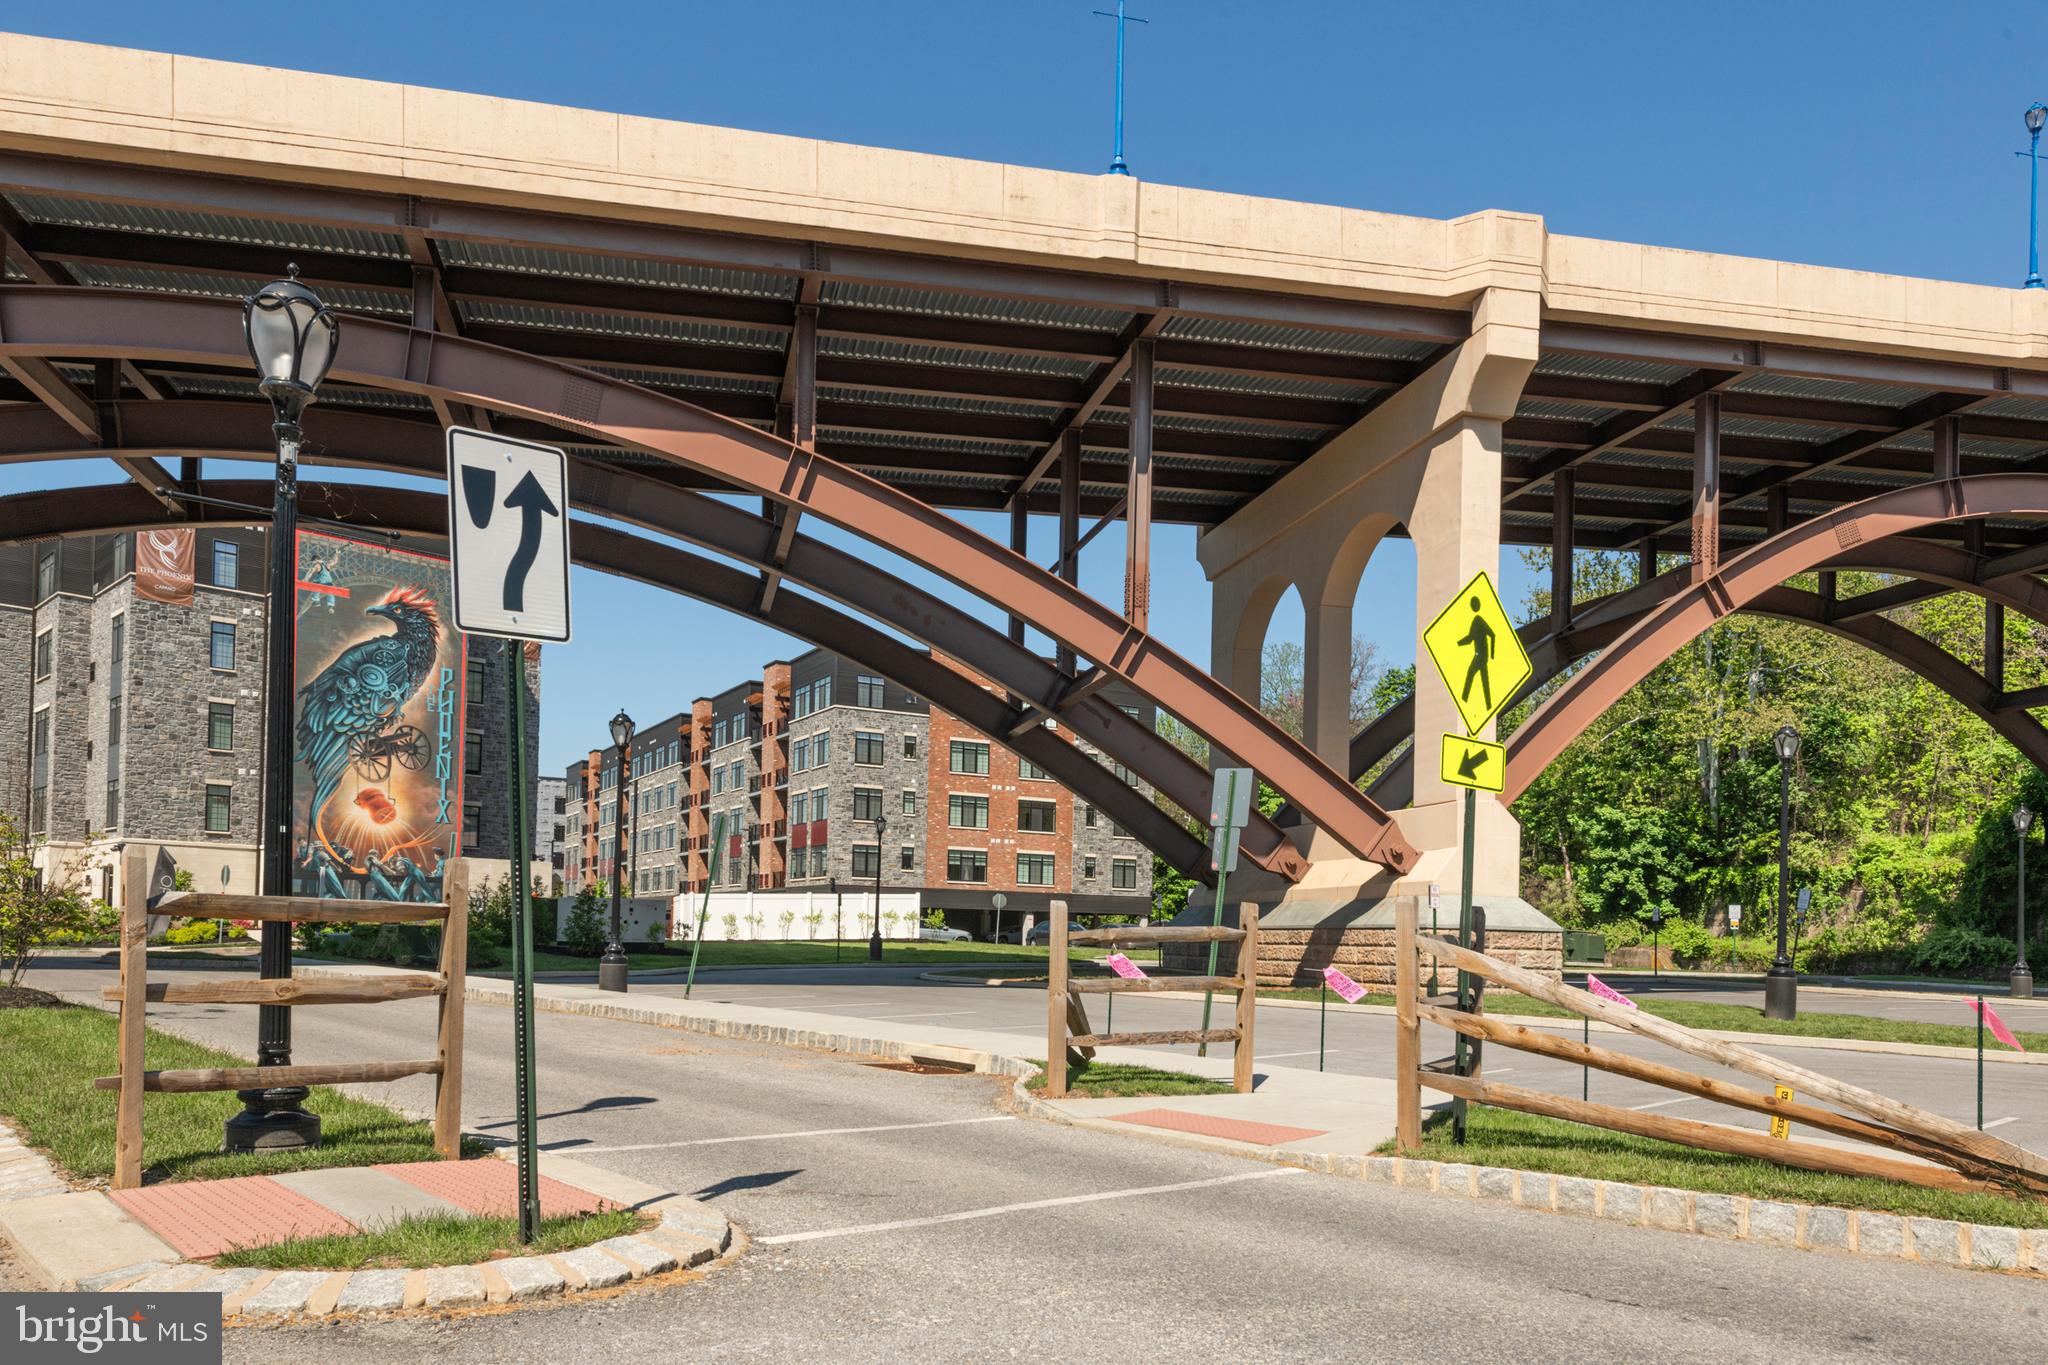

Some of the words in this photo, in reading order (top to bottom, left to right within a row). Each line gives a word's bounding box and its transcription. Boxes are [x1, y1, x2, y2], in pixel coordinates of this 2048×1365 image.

[139, 566, 156, 575] THE
[156, 569, 192, 580] PHOENIX
[427, 685, 435, 712] THE
[435, 667, 454, 824] PHOENIX
